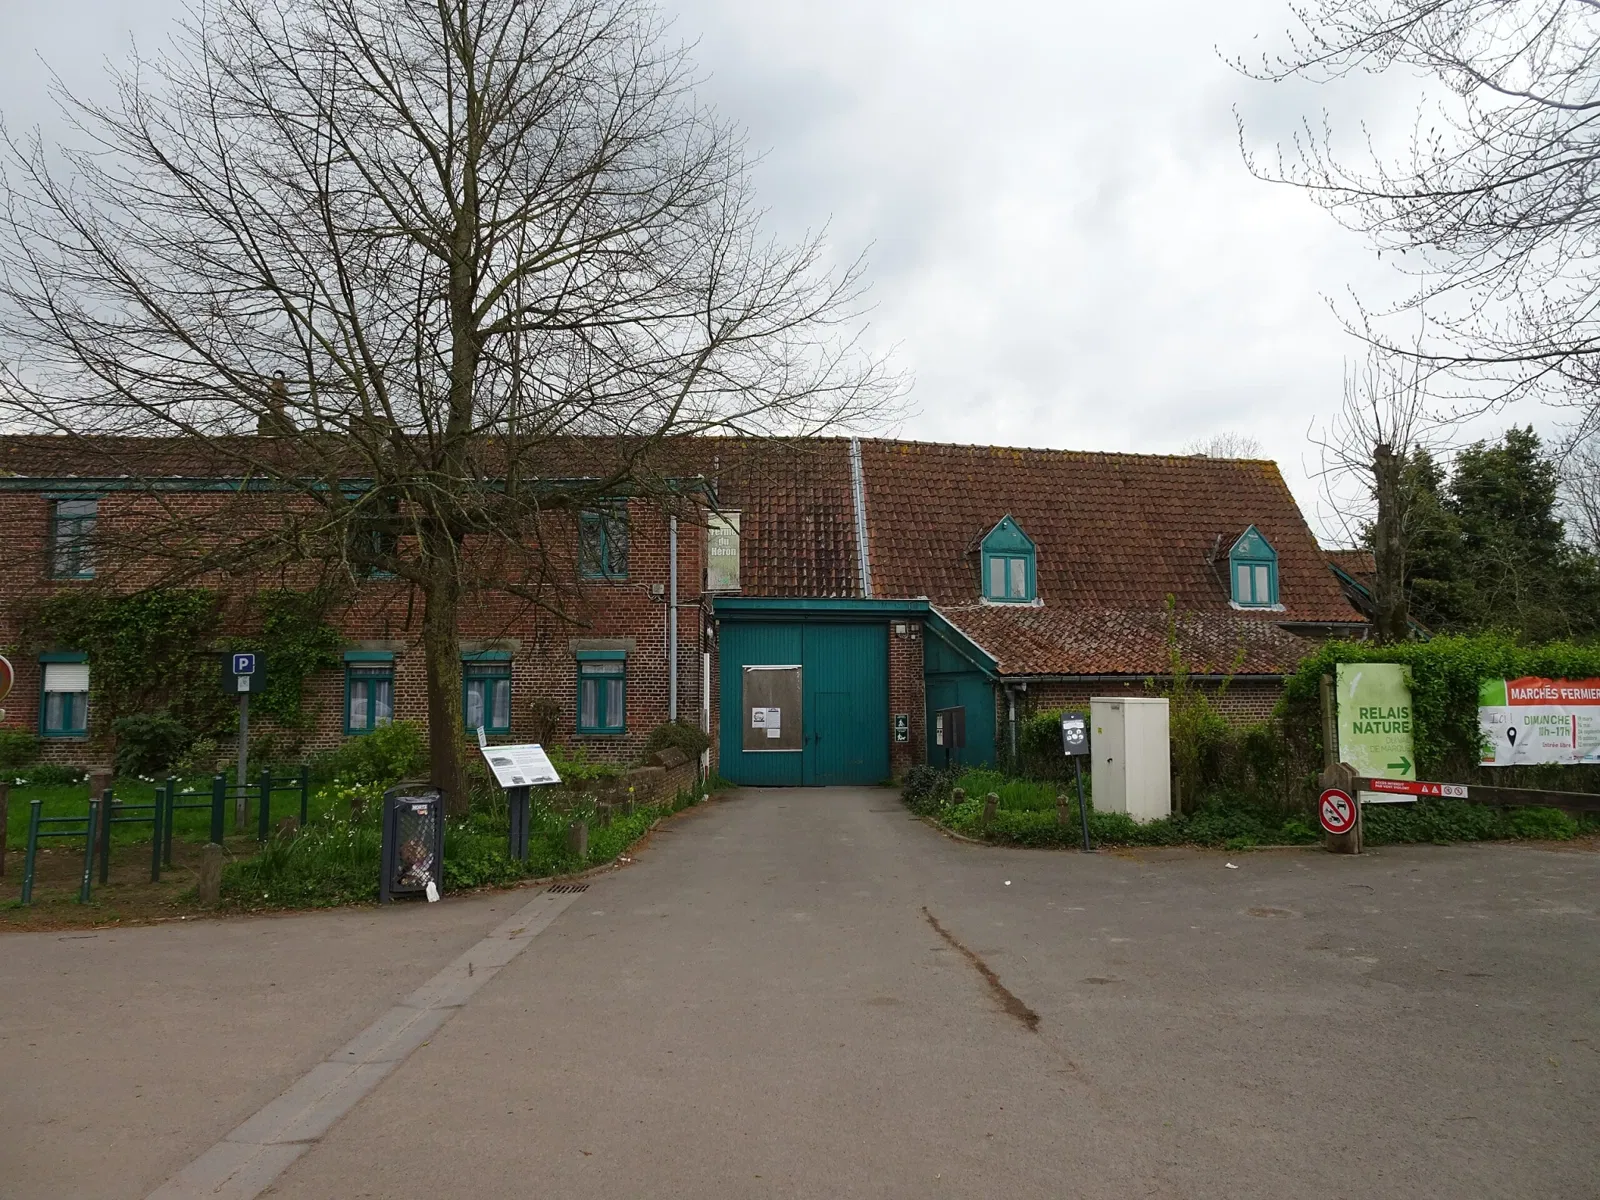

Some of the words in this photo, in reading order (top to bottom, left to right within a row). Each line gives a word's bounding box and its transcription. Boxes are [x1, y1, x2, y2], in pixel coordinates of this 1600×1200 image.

[719, 537, 729, 546] du
[711, 547, 737, 556] Héron
[239, 657, 249, 670] P
[1511, 685, 1559, 699] MARCHÉS
[1360, 707, 1409, 719] RELAIS
[1524, 715, 1571, 725] DIMANCHE
[1353, 721, 1409, 734] NATURE
